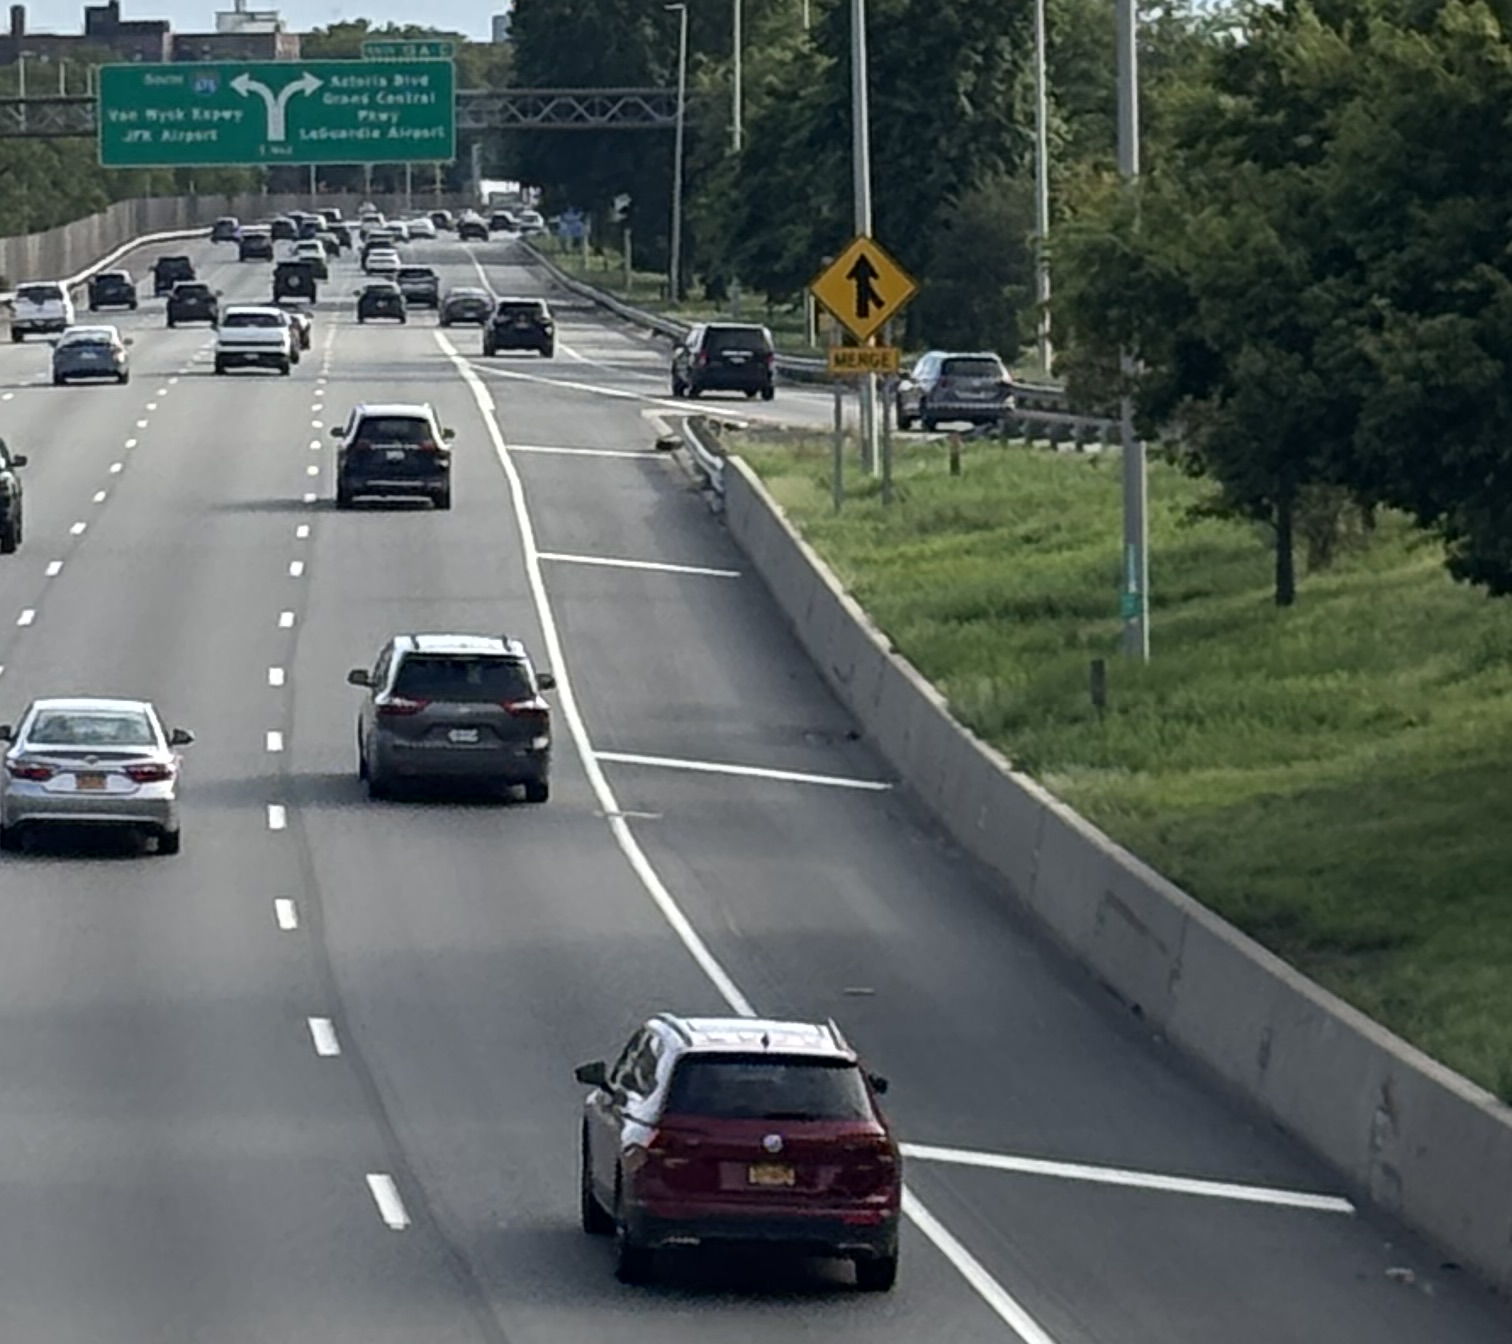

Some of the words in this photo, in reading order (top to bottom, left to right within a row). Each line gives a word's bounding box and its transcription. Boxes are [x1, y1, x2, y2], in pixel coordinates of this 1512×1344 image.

[330, 75, 387, 88] Astoria
[393, 74, 430, 87] Blvd
[322, 92, 370, 105] Grand
[376, 91, 436, 105] Central
[108, 109, 138, 122] Van
[356, 110, 400, 124] Pkwy
[121, 129, 152, 143] JFK
[160, 129, 218, 144] Airport
[299, 127, 381, 141] LaGuardia
[387, 126, 446, 140] Airport
[834, 352, 890, 368] MERGE
